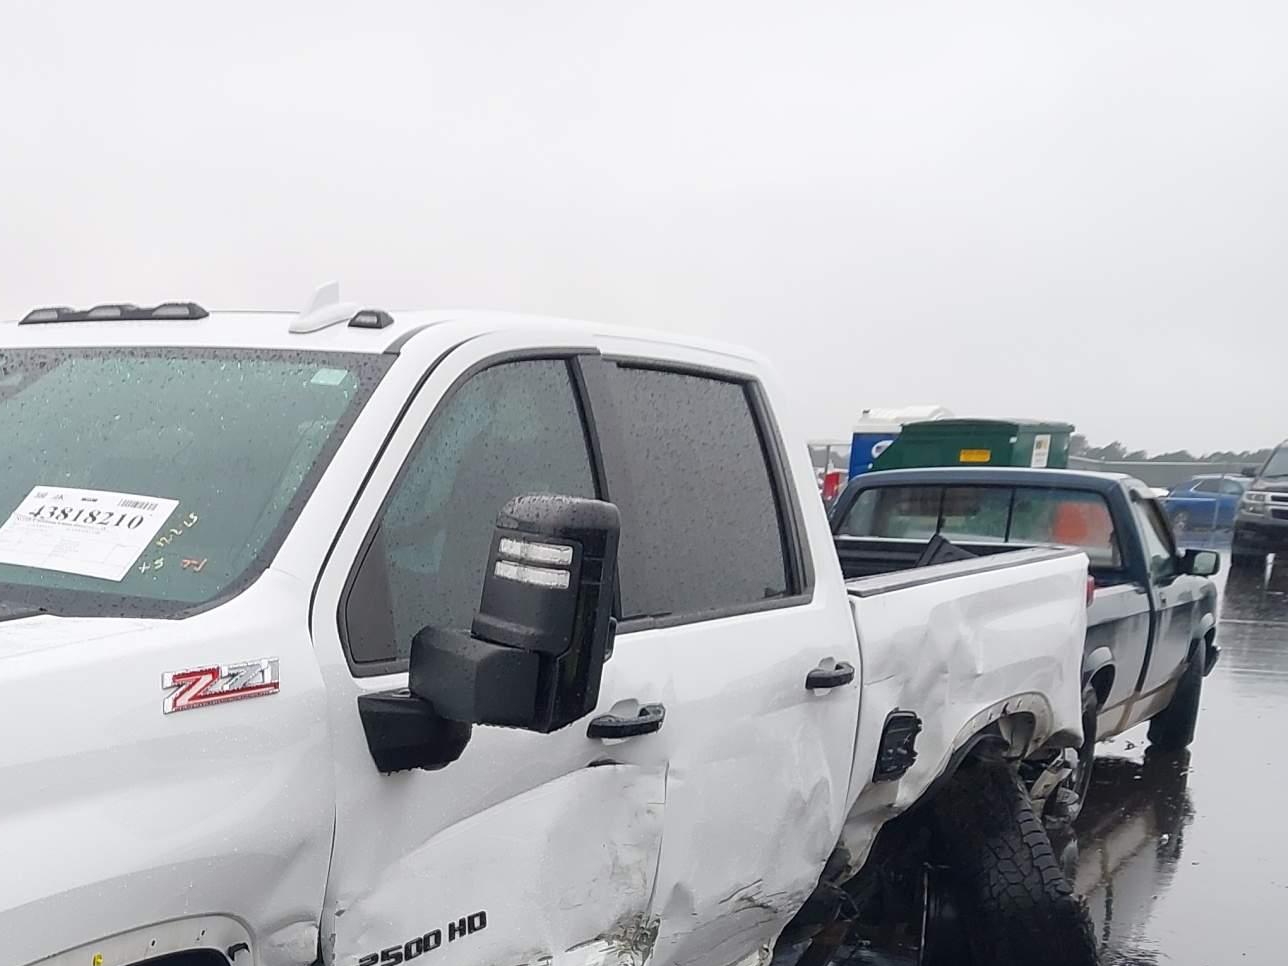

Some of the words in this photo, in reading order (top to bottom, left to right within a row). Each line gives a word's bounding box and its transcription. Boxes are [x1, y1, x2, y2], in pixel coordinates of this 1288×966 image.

[29, 505, 144, 529] 43818210
[162, 657, 280, 714] Z71
[447, 910, 488, 943] HD
